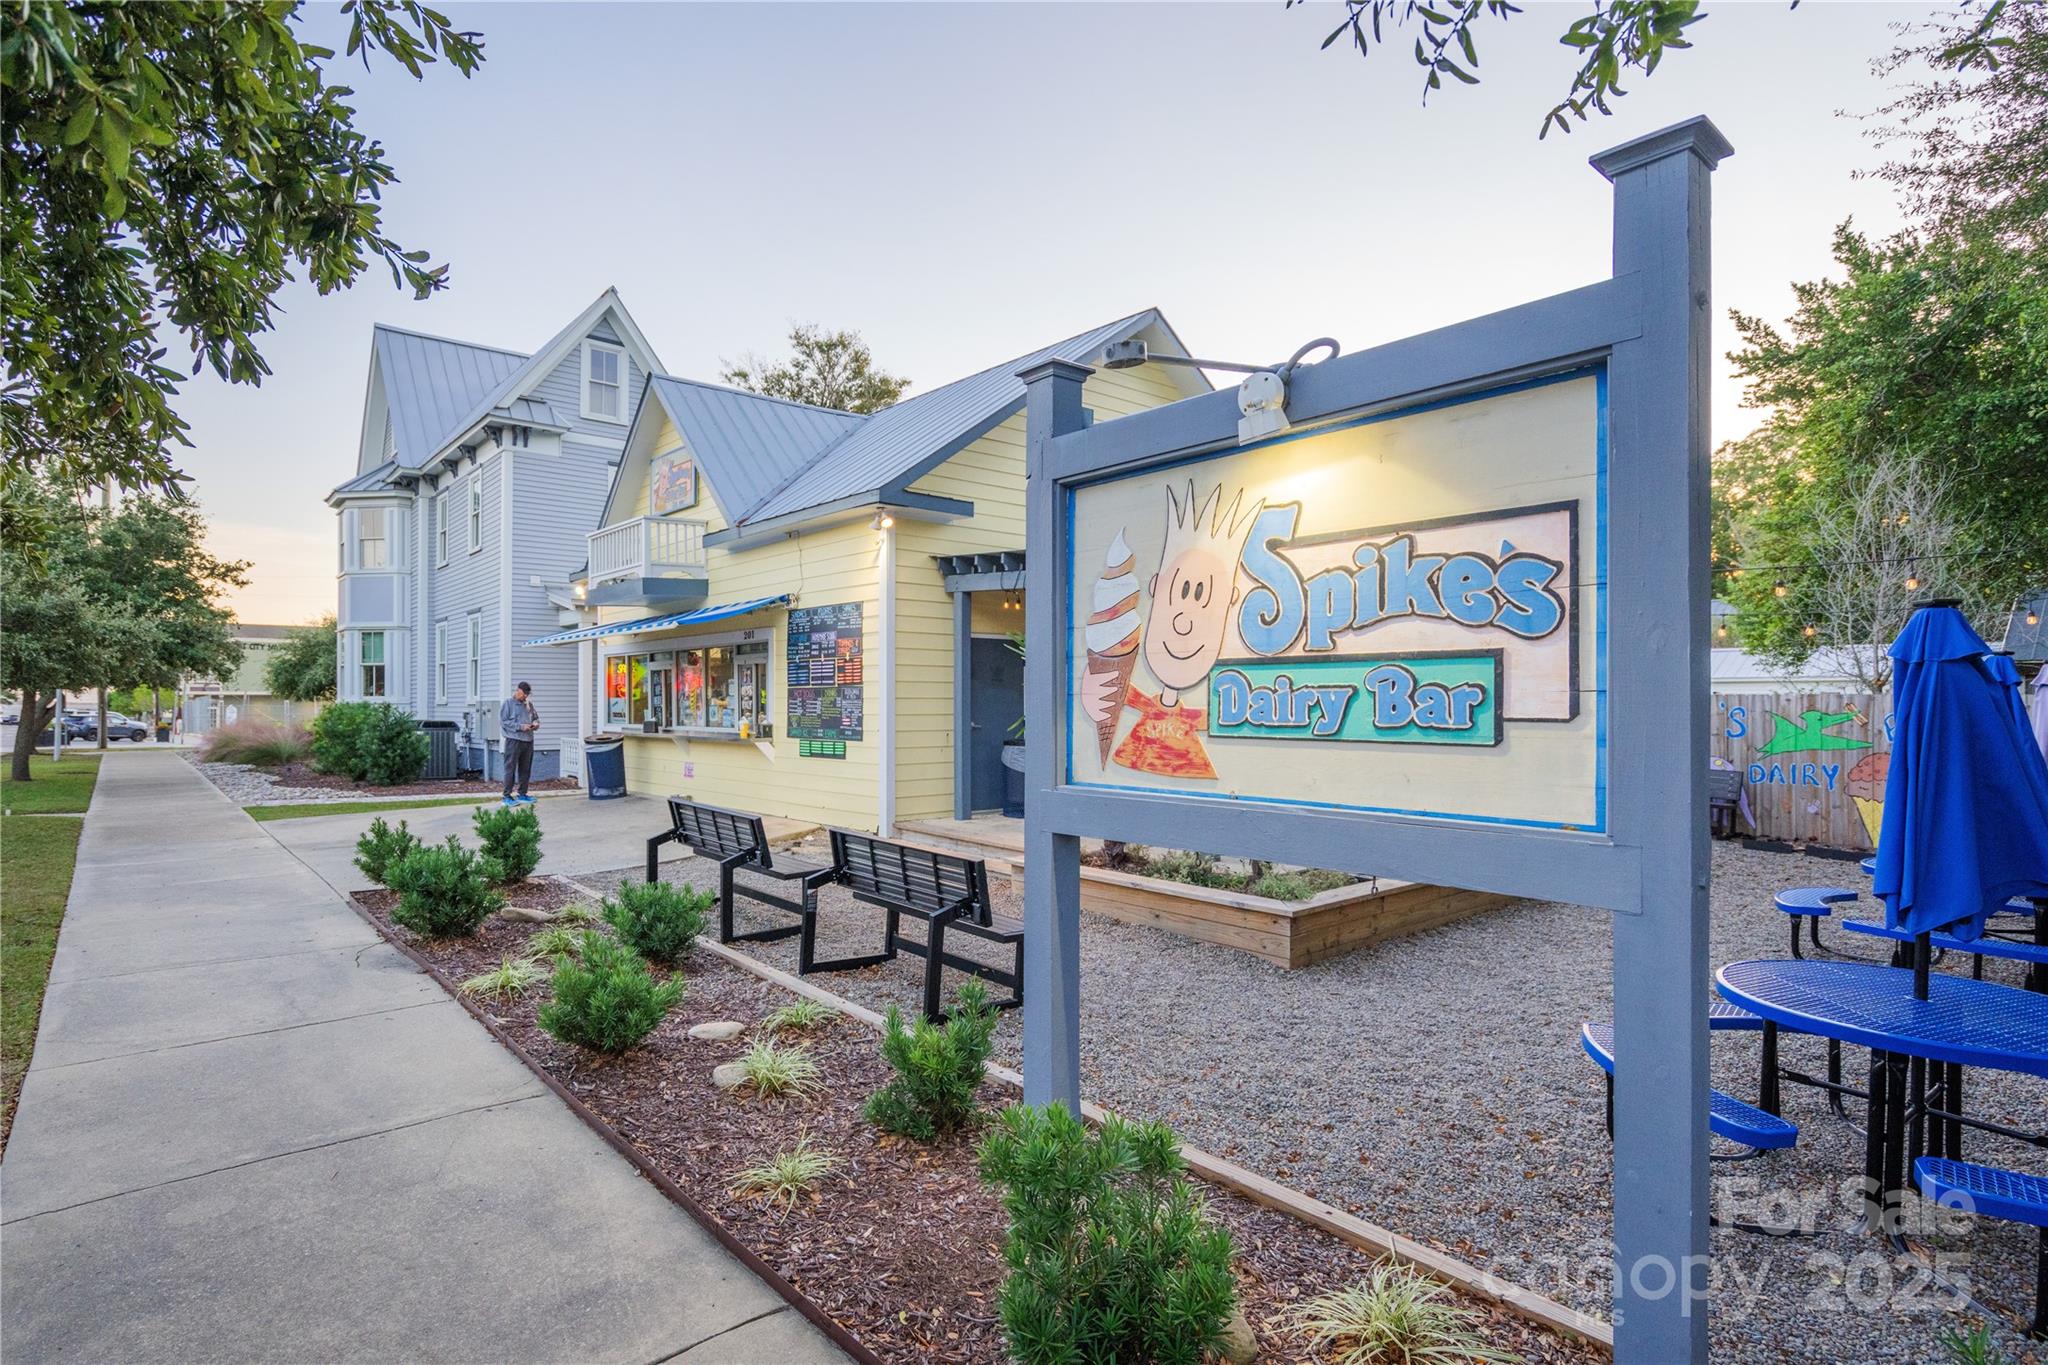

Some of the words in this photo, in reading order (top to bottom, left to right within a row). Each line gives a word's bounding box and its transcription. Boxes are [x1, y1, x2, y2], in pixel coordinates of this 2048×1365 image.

[1238, 501, 1566, 657] Spike's
[743, 629, 755, 640] 201
[1214, 669, 1356, 736] Dairy
[1364, 664, 1486, 730] Bar
[1749, 762, 1840, 791] DAIRY
